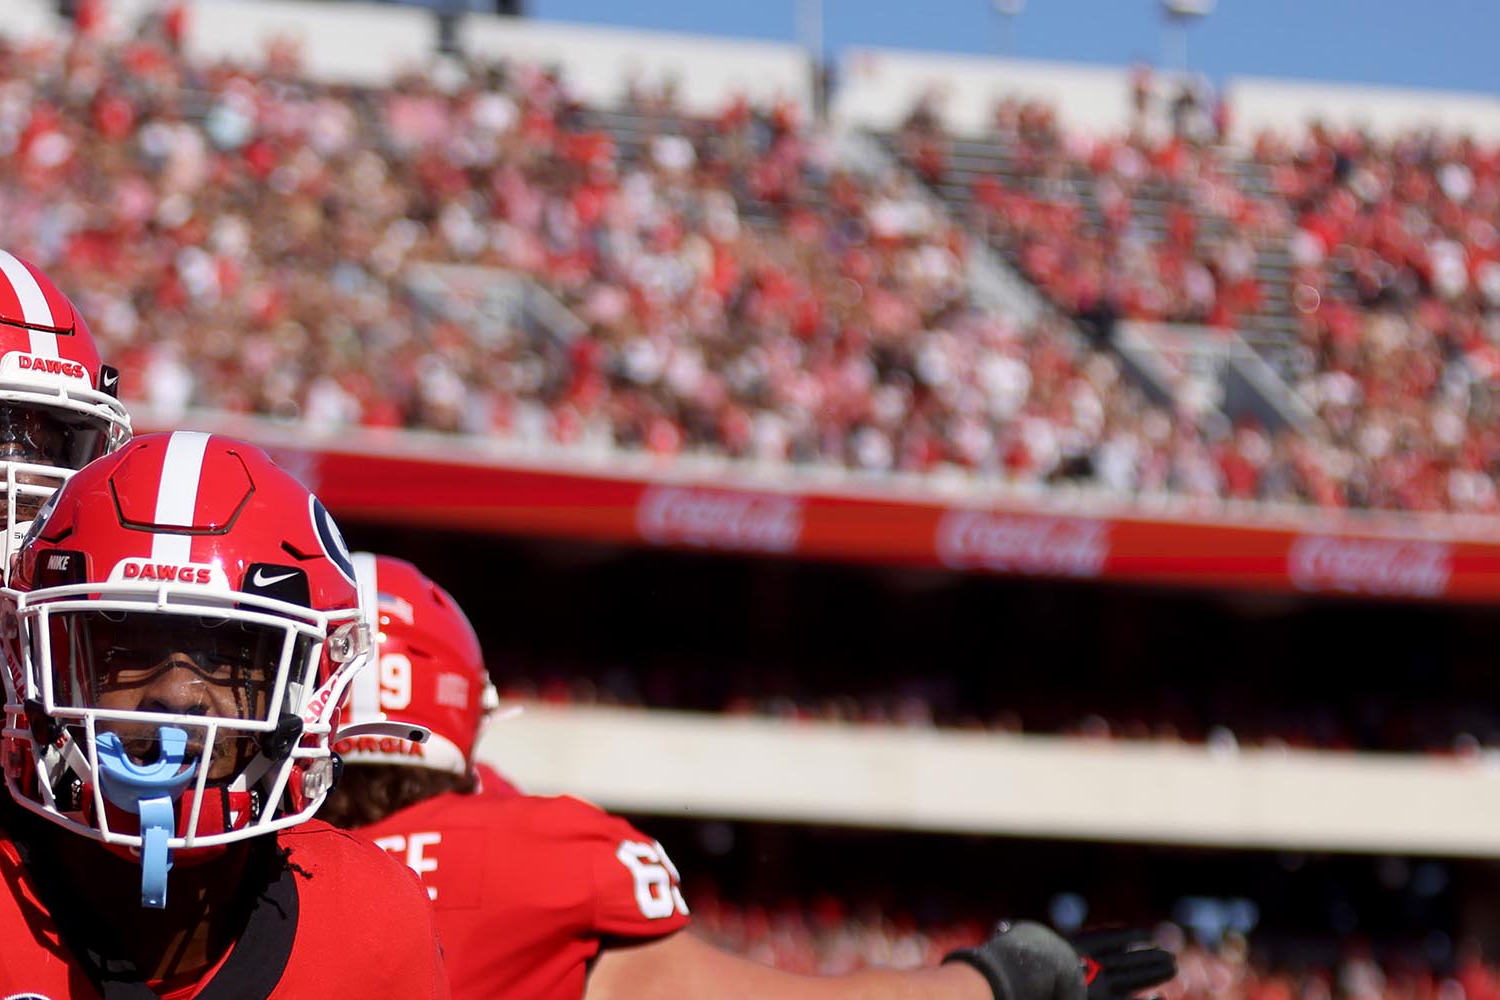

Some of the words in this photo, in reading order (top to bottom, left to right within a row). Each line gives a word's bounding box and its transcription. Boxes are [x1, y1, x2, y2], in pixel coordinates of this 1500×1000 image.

[18, 354, 85, 378] DAWGS
[47, 554, 71, 571] NIKE
[122, 562, 212, 585] DAWGS
